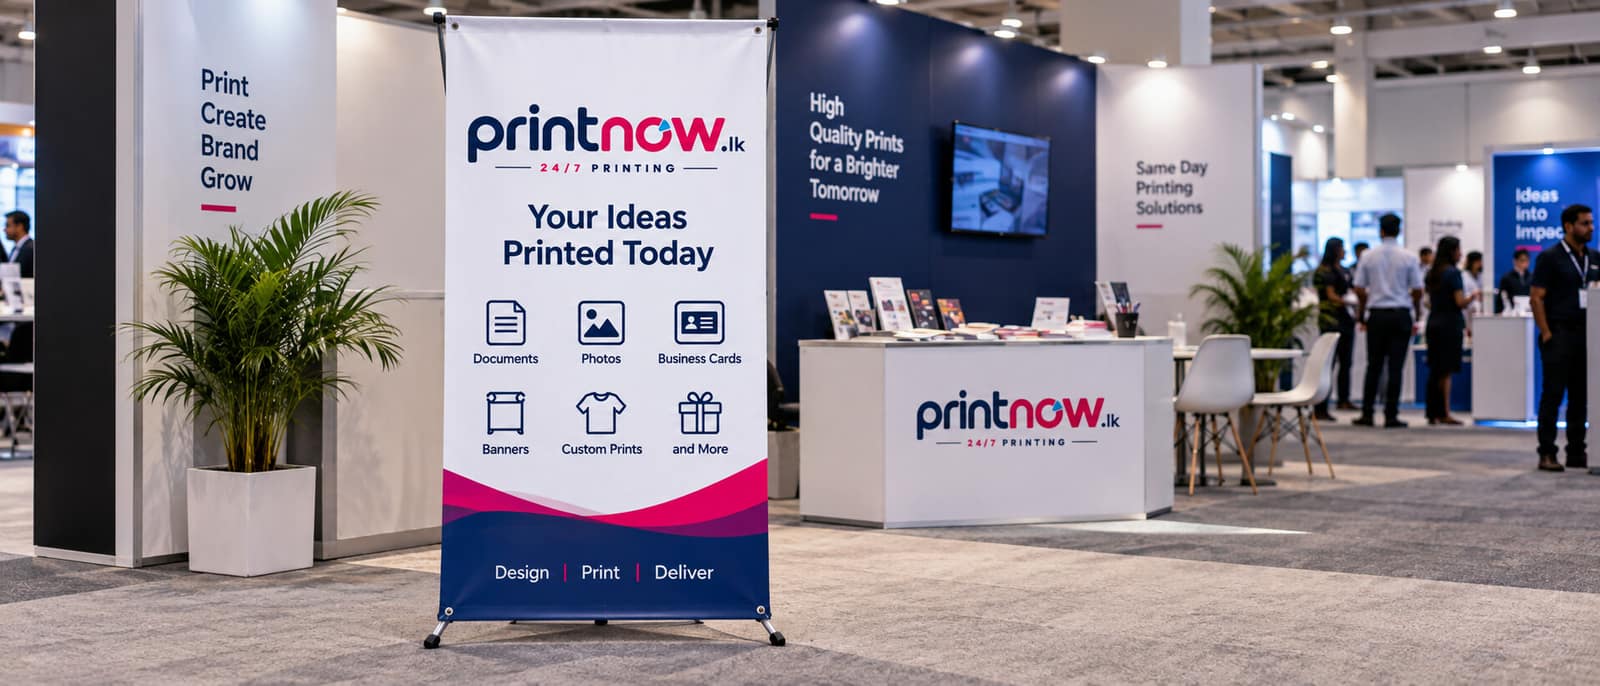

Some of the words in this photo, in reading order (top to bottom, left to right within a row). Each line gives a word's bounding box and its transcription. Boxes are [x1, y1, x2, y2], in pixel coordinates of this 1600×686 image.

[201, 68, 249, 97] Print
[809, 91, 845, 119] High
[201, 102, 266, 131] Create
[467, 104, 745, 163] printnow.lk
[809, 121, 863, 152] Quality
[865, 129, 904, 154] Prints
[201, 134, 259, 161] Brand
[540, 163, 581, 173] 24/7
[591, 164, 676, 173] PRINTING
[809, 149, 831, 171] for
[833, 157, 843, 173] a
[846, 154, 900, 180] Brighter
[1136, 160, 1176, 176] Same
[1180, 159, 1208, 177] Day
[201, 166, 252, 192] Grow
[1136, 179, 1193, 197] Printing
[809, 177, 880, 203] Tomorrow
[1515, 186, 1559, 203] Ideas
[528, 204, 598, 229] Your
[607, 203, 688, 229] Ideas
[1136, 200, 1204, 216] Solutions
[1515, 204, 1548, 221] into
[1515, 223, 1564, 242] Impac
[503, 239, 614, 265] Printed
[623, 240, 714, 271] Today
[473, 353, 539, 365] Documents
[581, 353, 622, 365] Photos
[658, 353, 706, 365] Business
[709, 353, 742, 365] Cards
[482, 443, 530, 456] Banners
[561, 443, 607, 456] Custom
[610, 443, 643, 456] Prints
[672, 443, 695, 456] and
[698, 444, 729, 456] More
[967, 438, 997, 448] 24/7
[1002, 438, 1066, 447] PRINTING
[495, 565, 550, 583] Design
[581, 565, 621, 580] Print
[655, 564, 714, 580] Deliver
